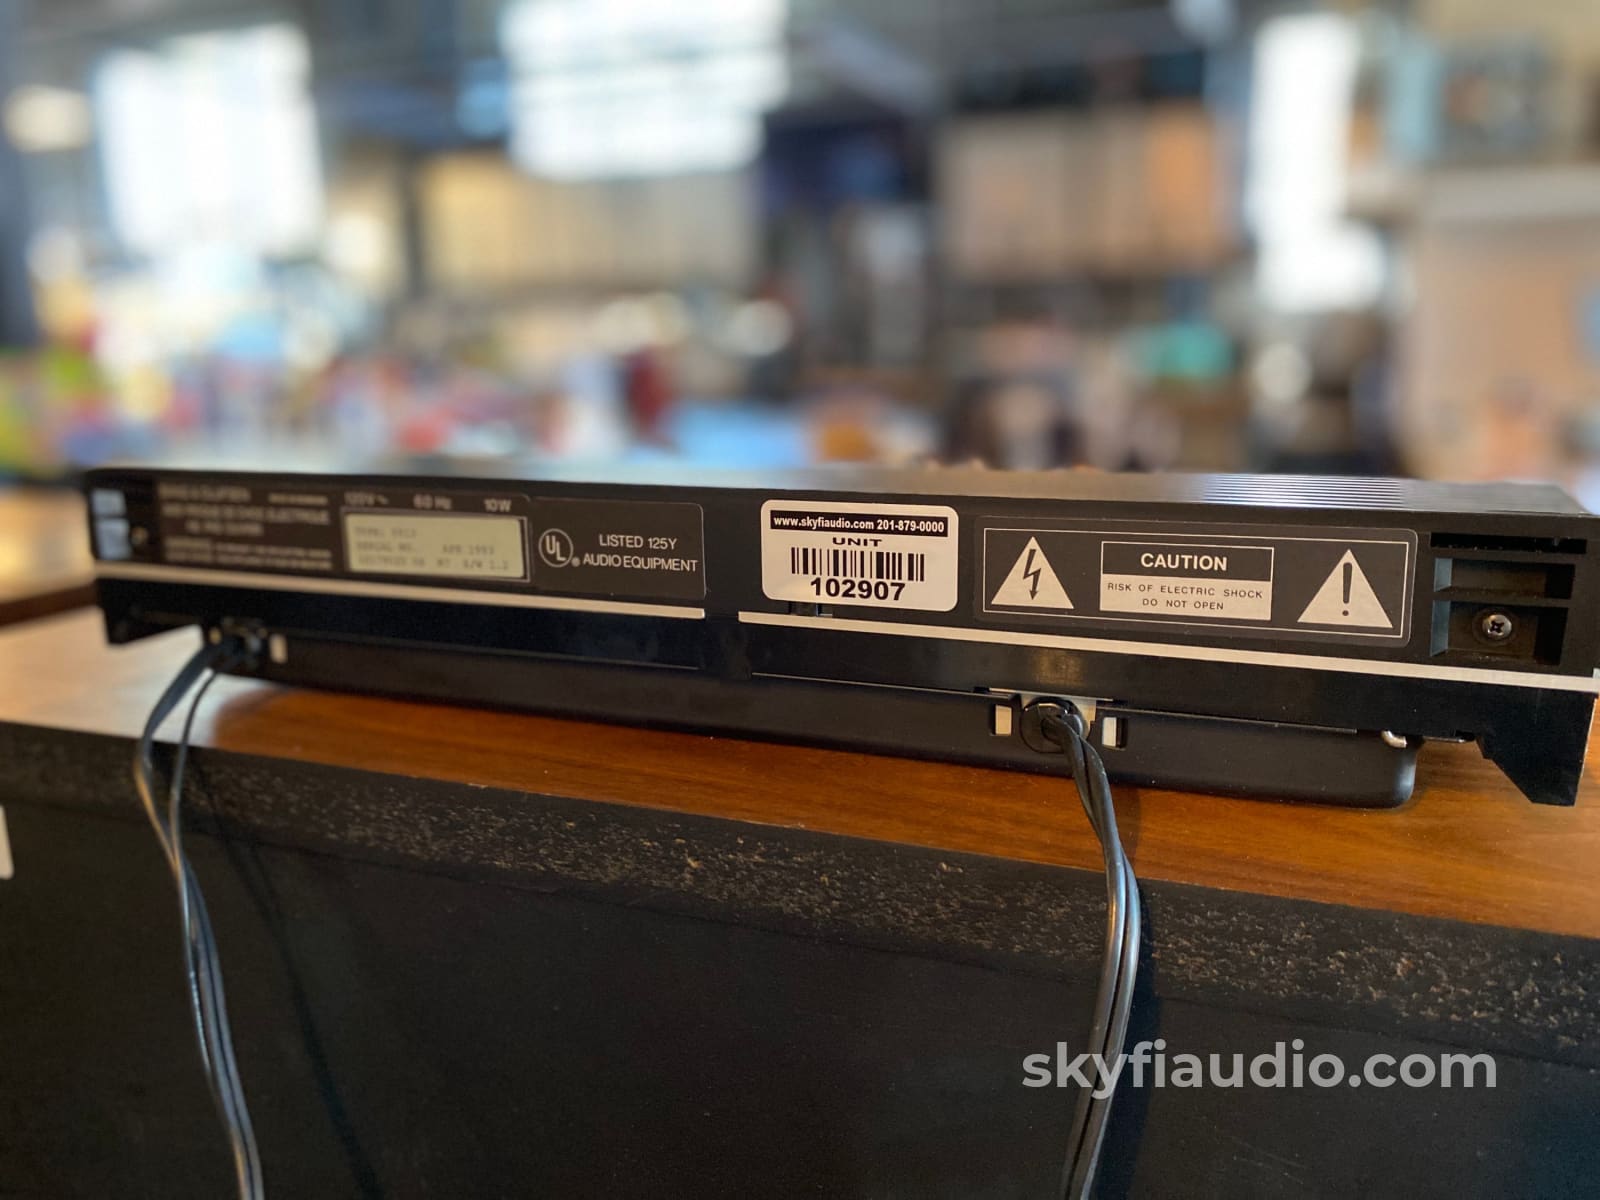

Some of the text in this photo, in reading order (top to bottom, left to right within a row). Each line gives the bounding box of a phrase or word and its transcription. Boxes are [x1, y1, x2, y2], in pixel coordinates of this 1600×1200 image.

[484, 498, 512, 512] 10W
[773, 516, 945, 533] www.skyfiaudio.com 201-879-0000
[599, 534, 677, 550] LISTED 125Y
[832, 537, 882, 547] UNIT
[583, 553, 698, 572] AUDIO EQUIPMENT
[1140, 553, 1227, 571] CAUTION
[810, 577, 906, 601] 102907
[1107, 583, 1263, 599] RISK OF ELECTRIC SHOCK
[1142, 599, 1224, 610] DO NOT OPEN
